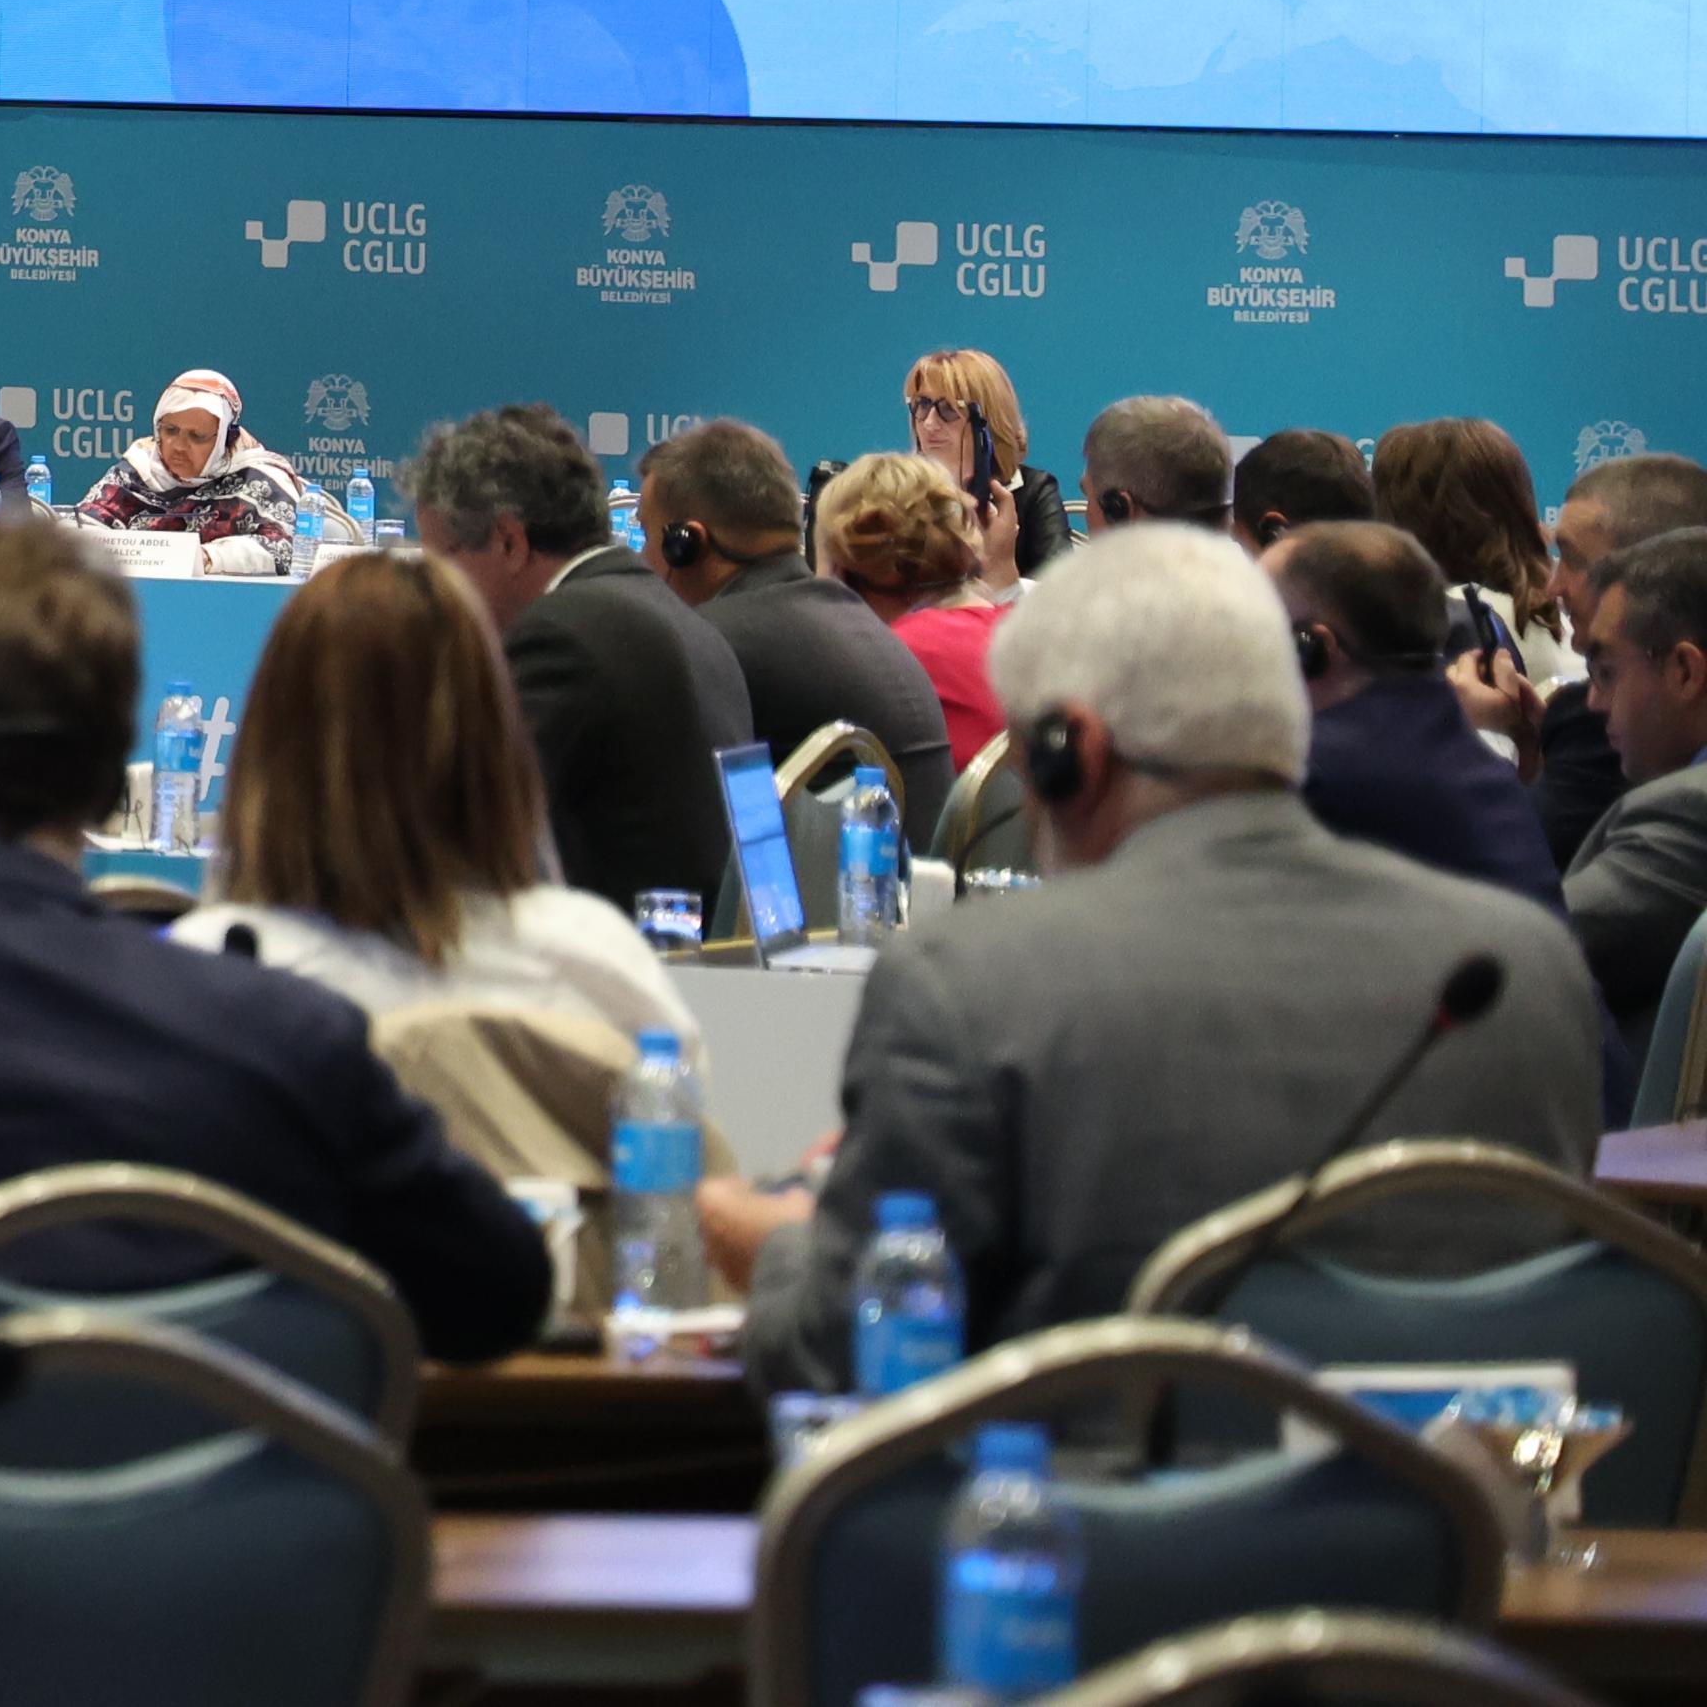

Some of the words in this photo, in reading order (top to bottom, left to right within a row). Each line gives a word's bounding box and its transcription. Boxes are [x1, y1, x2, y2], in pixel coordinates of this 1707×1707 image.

[344, 202, 426, 236] UCLG
[16, 228, 71, 244] KONYA
[957, 223, 1045, 258] UCLG
[344, 239, 425, 274] CGLU
[607, 249, 665, 264] KONYA
[957, 263, 1045, 297] CGLU
[1240, 268, 1303, 284] KONYA
[54, 389, 133, 422] UCLG
[309, 437, 365, 455] KONYA
[139, 539, 171, 547] ABDEL
